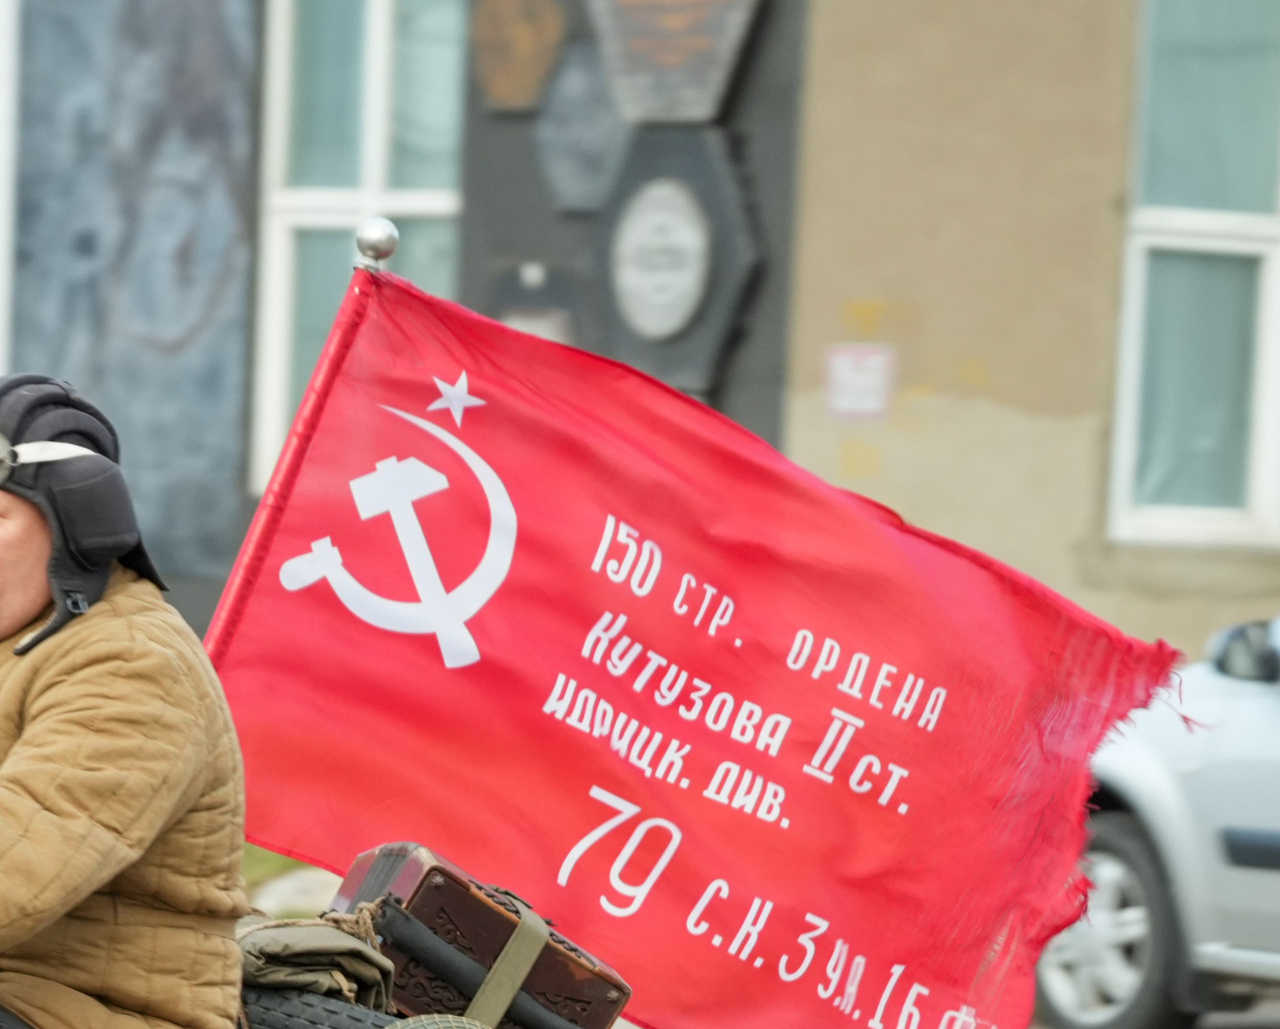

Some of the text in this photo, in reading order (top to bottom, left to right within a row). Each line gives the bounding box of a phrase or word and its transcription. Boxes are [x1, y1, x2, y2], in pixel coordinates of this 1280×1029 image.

[589, 513, 948, 733] 150 СТР. ОРДЕНА
[541, 671, 791, 830] ИДРИЦК. ДИВ.
[556, 784, 684, 919] 79
